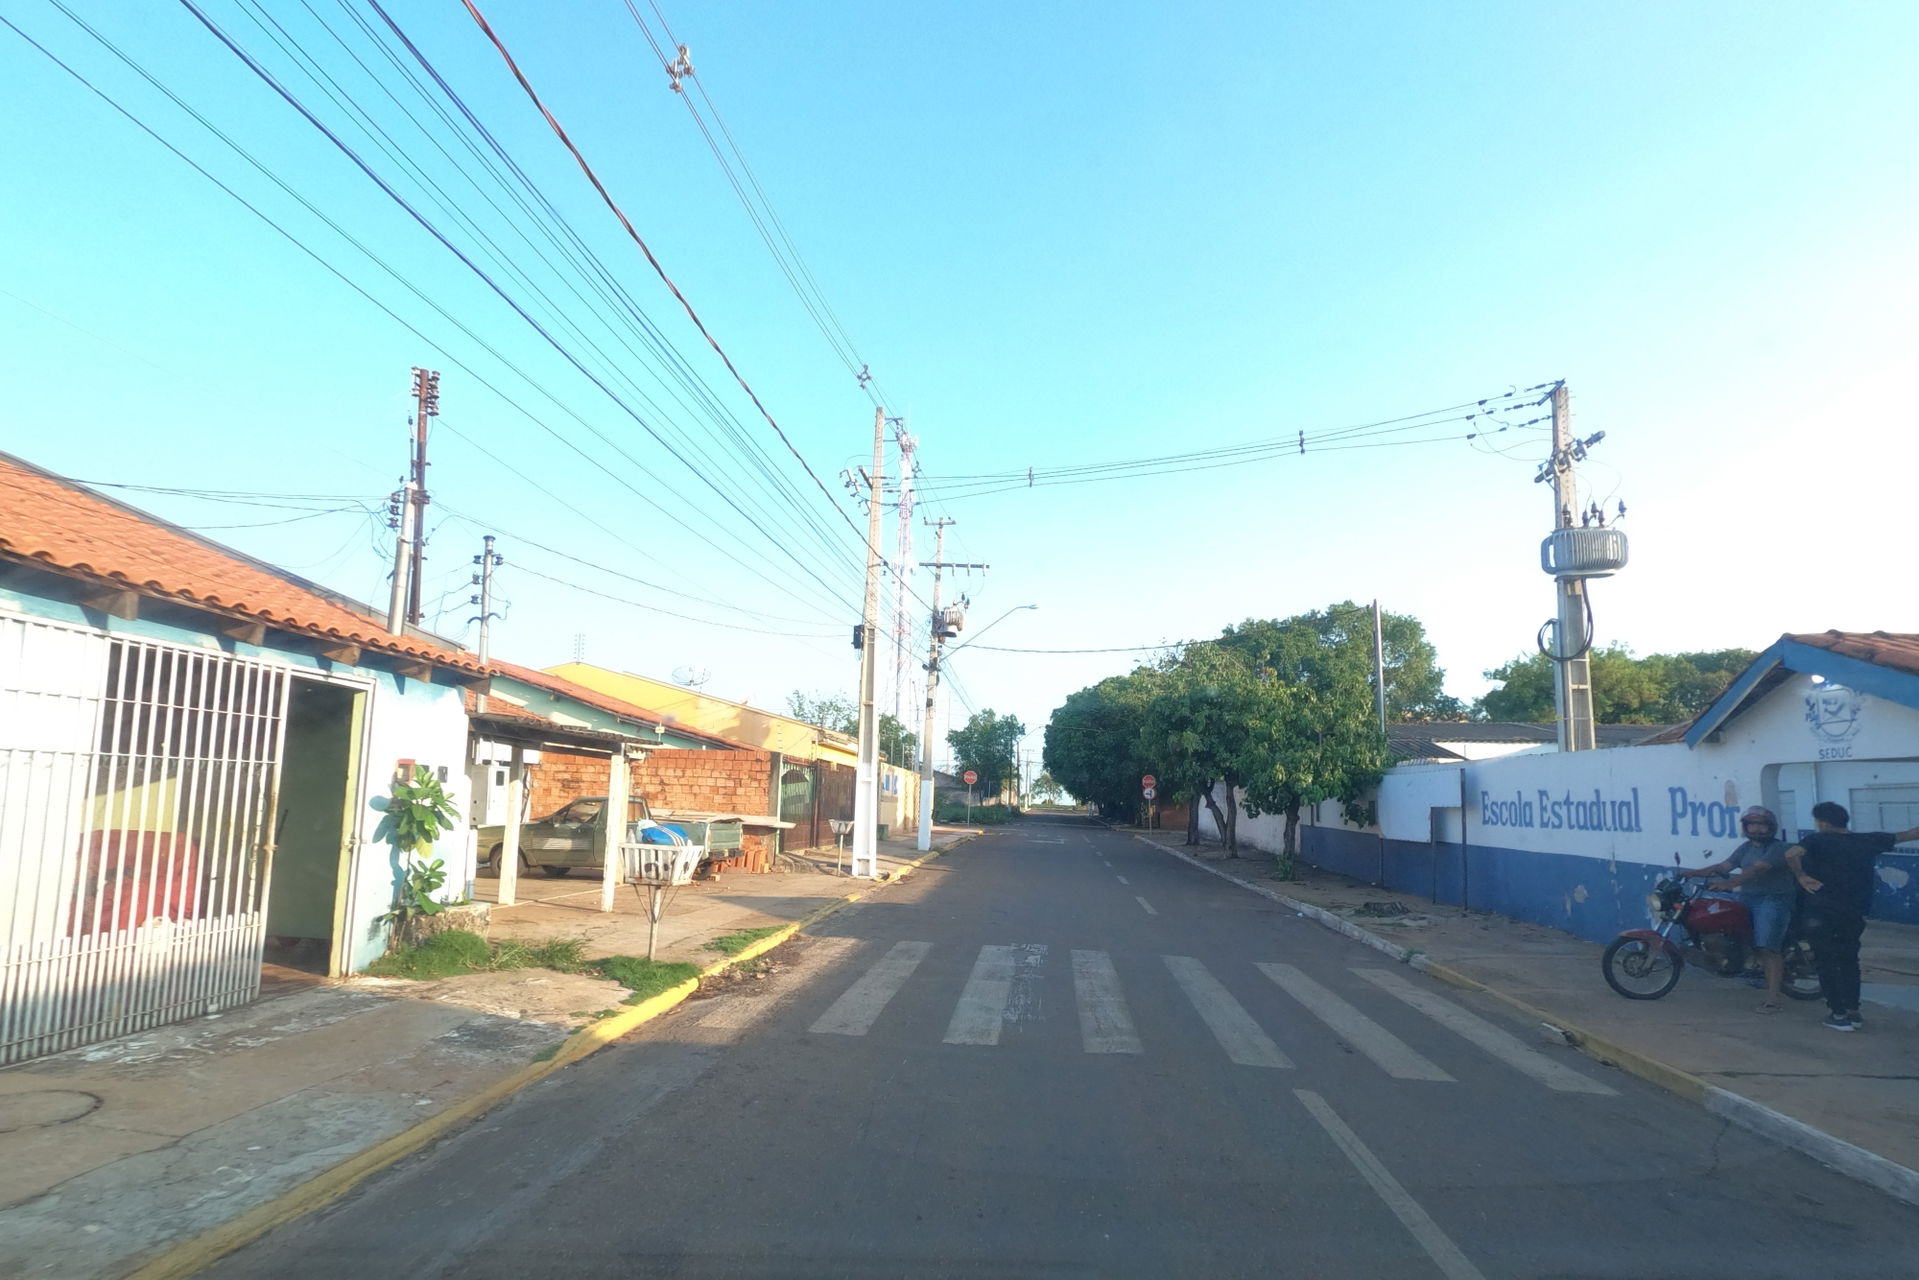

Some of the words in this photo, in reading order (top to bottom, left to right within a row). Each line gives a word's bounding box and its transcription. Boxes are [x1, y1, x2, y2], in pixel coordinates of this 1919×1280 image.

[1818, 746, 1853, 760] SEDUC
[1481, 790, 1534, 828] Escola
[1537, 787, 1642, 832] Estadual
